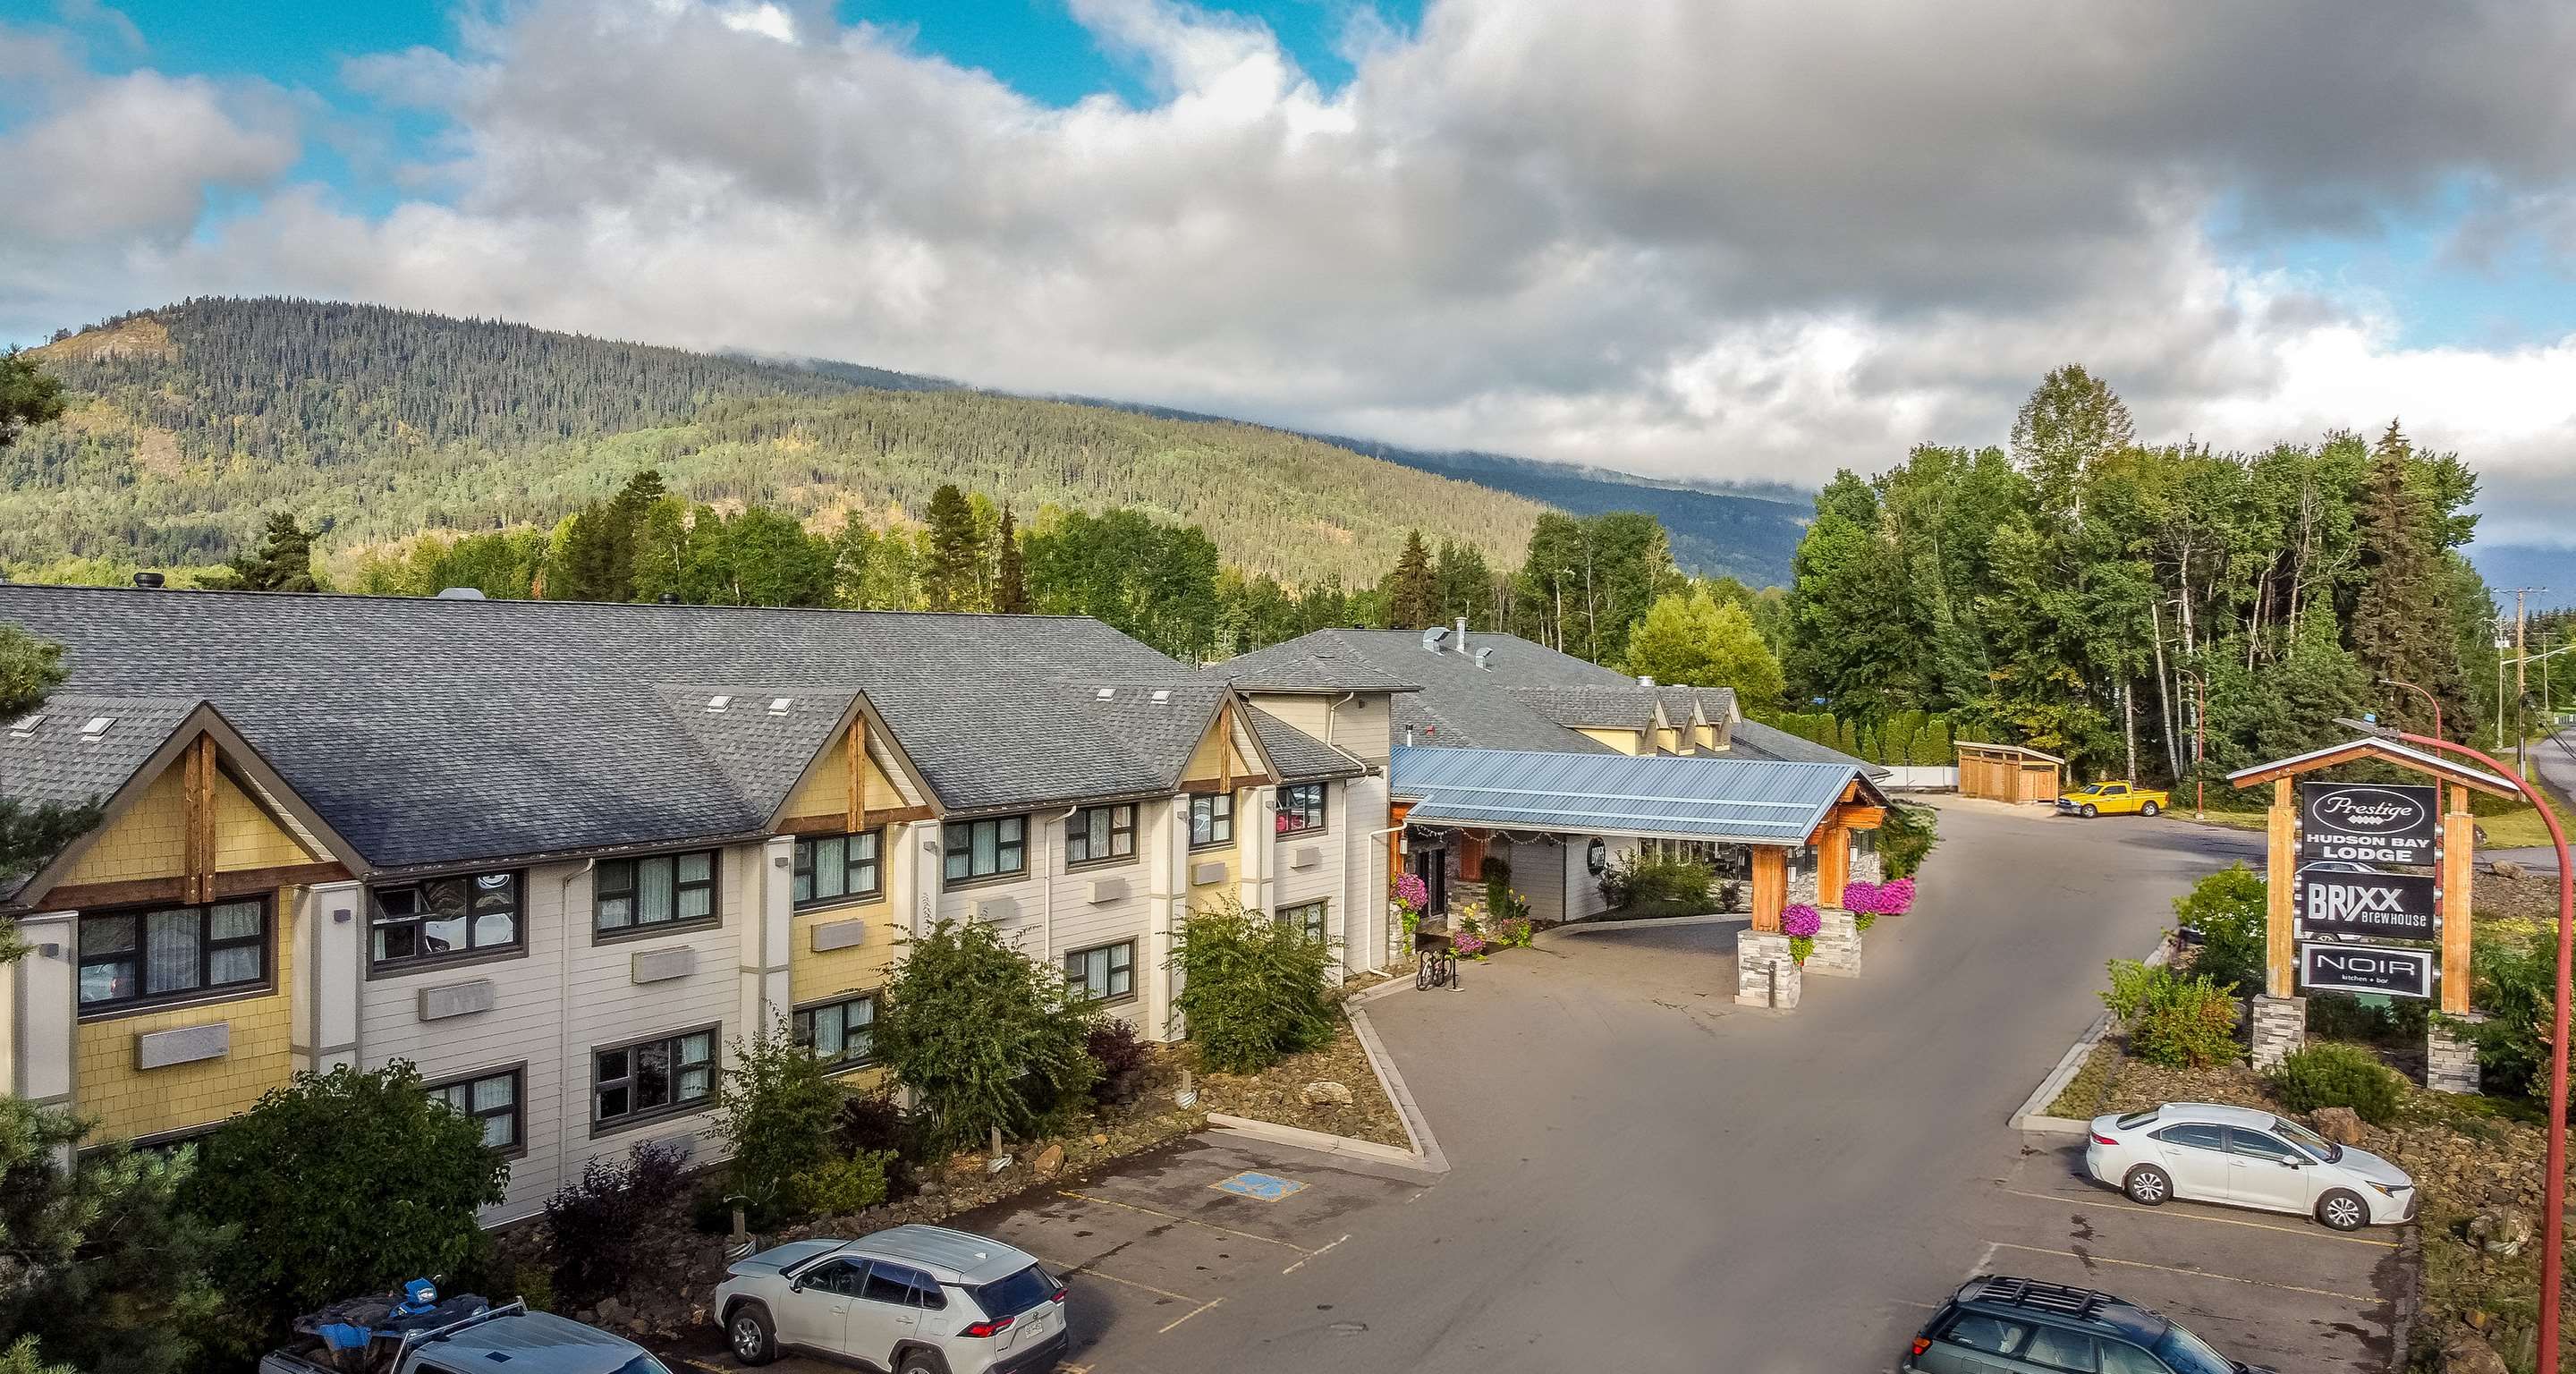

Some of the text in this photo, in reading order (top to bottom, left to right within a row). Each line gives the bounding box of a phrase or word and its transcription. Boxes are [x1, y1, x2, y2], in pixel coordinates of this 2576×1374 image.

[2324, 797, 2412, 821] Prestige
[2307, 835, 2430, 848] HUDSON BAY
[2323, 846, 2412, 862] LODGE
[2308, 883, 2404, 921] BRIXX
[2317, 954, 2415, 976] NOIR
[2342, 974, 2368, 983] kitchen
